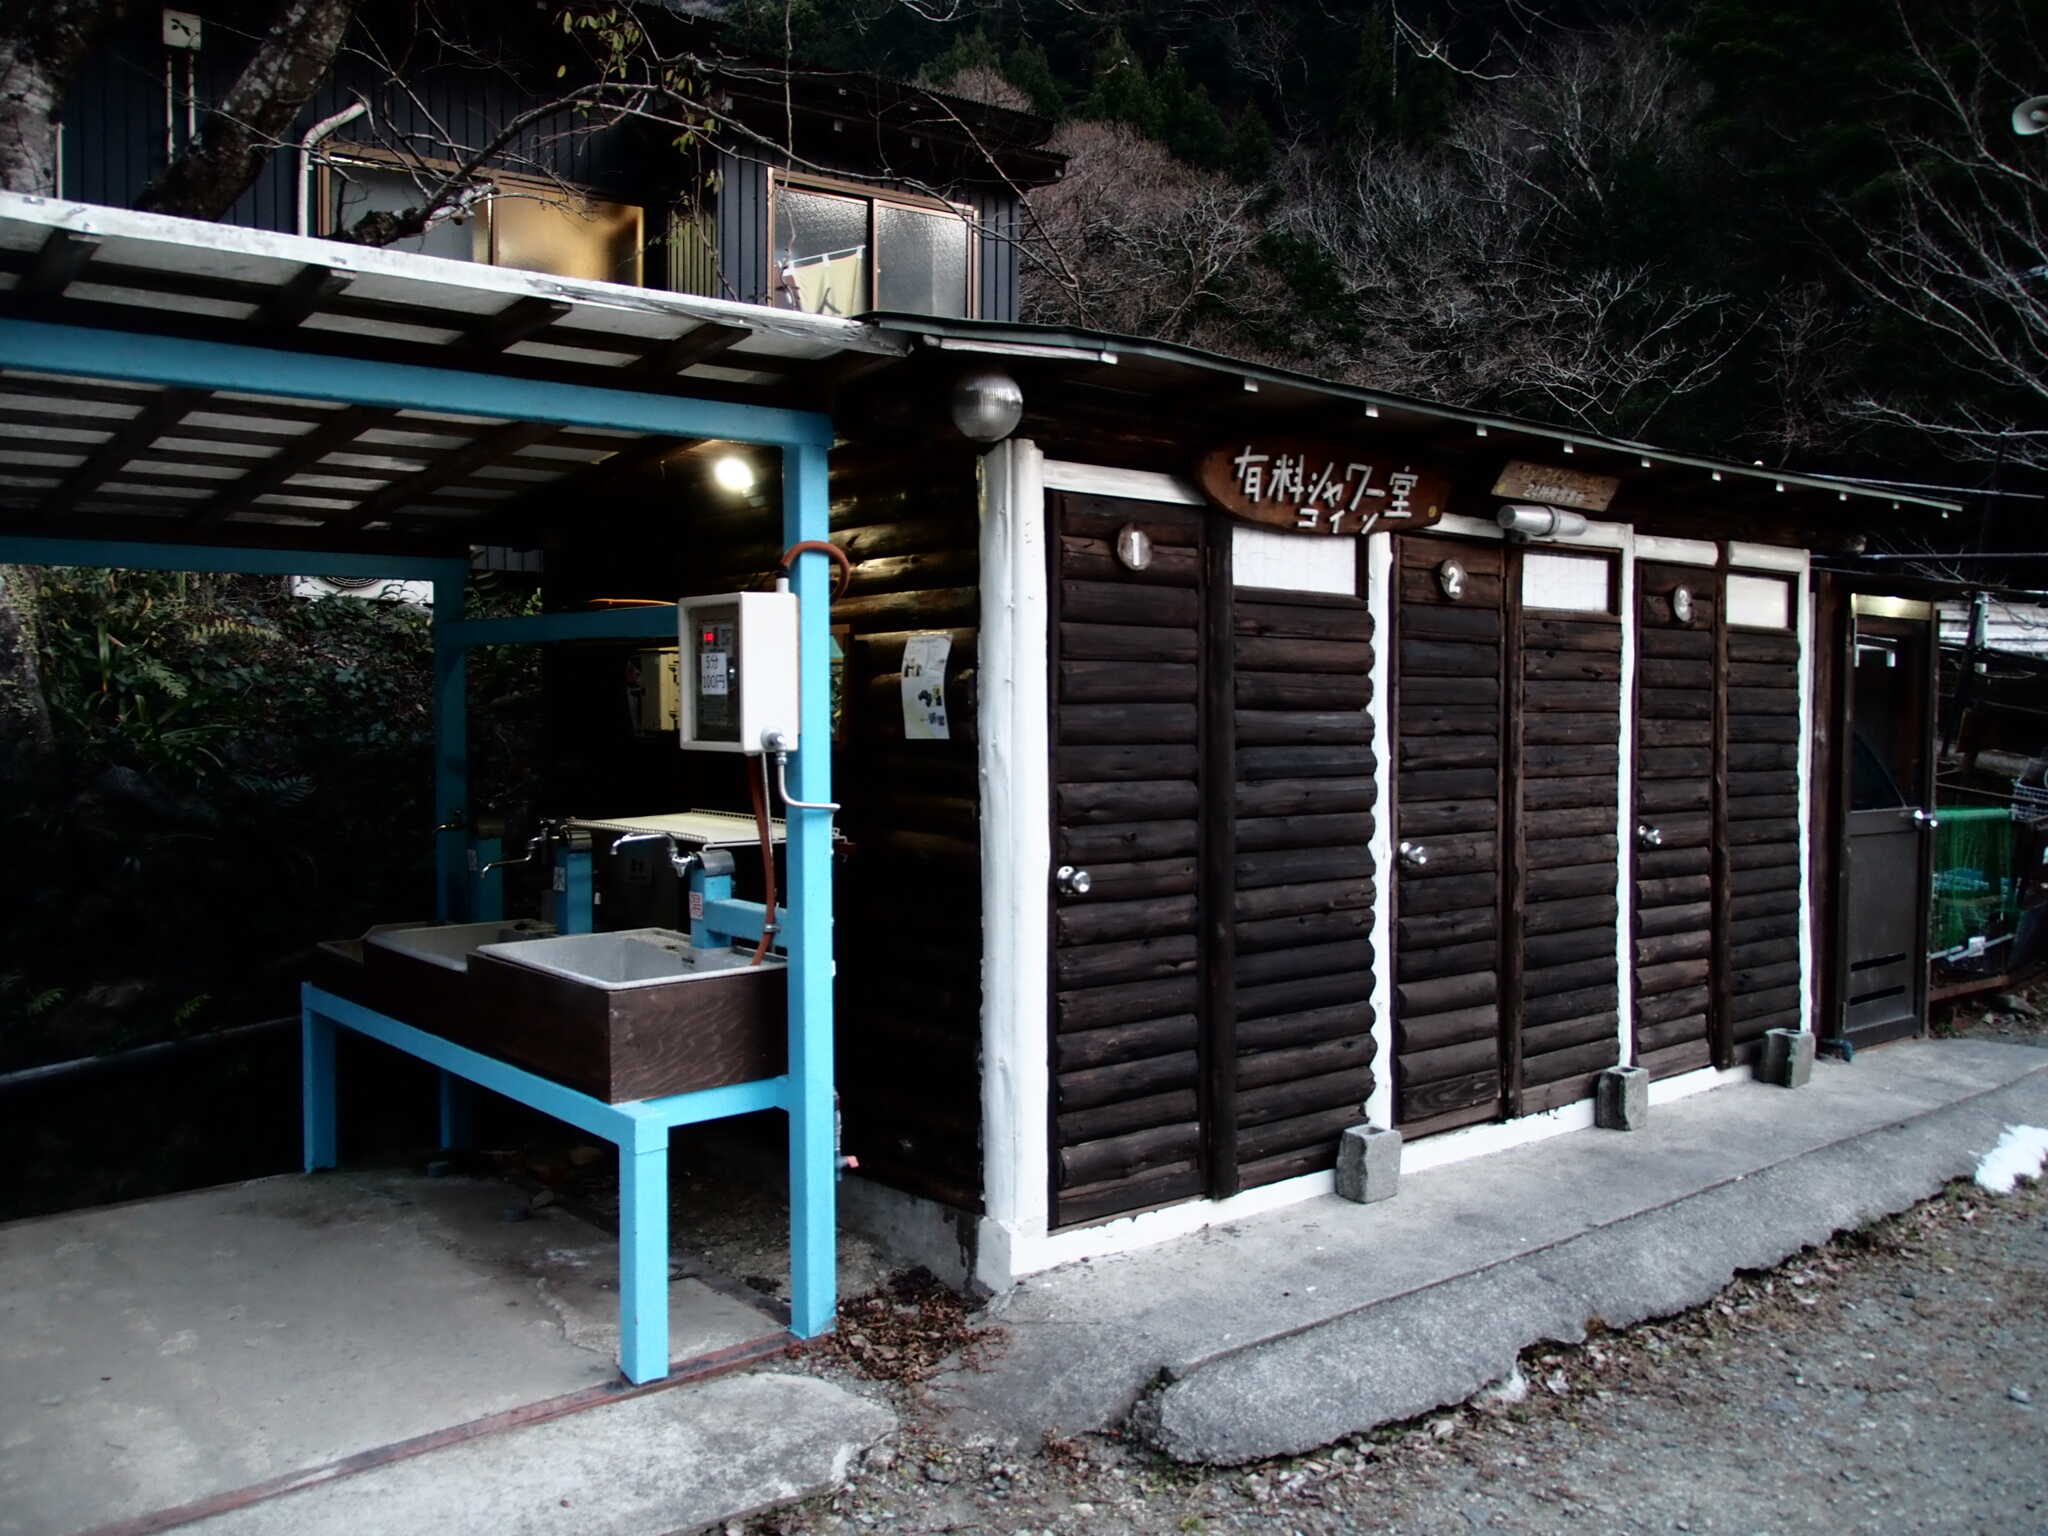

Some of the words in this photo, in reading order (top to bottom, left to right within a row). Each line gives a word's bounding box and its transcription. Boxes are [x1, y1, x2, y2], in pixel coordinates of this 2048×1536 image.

[1234, 445, 1418, 518] 有料シャワー室
[1298, 508, 1379, 534] コイン
[1131, 531, 1140, 566] 1
[1448, 566, 1460, 594] 2
[1679, 590, 1689, 613] 3
